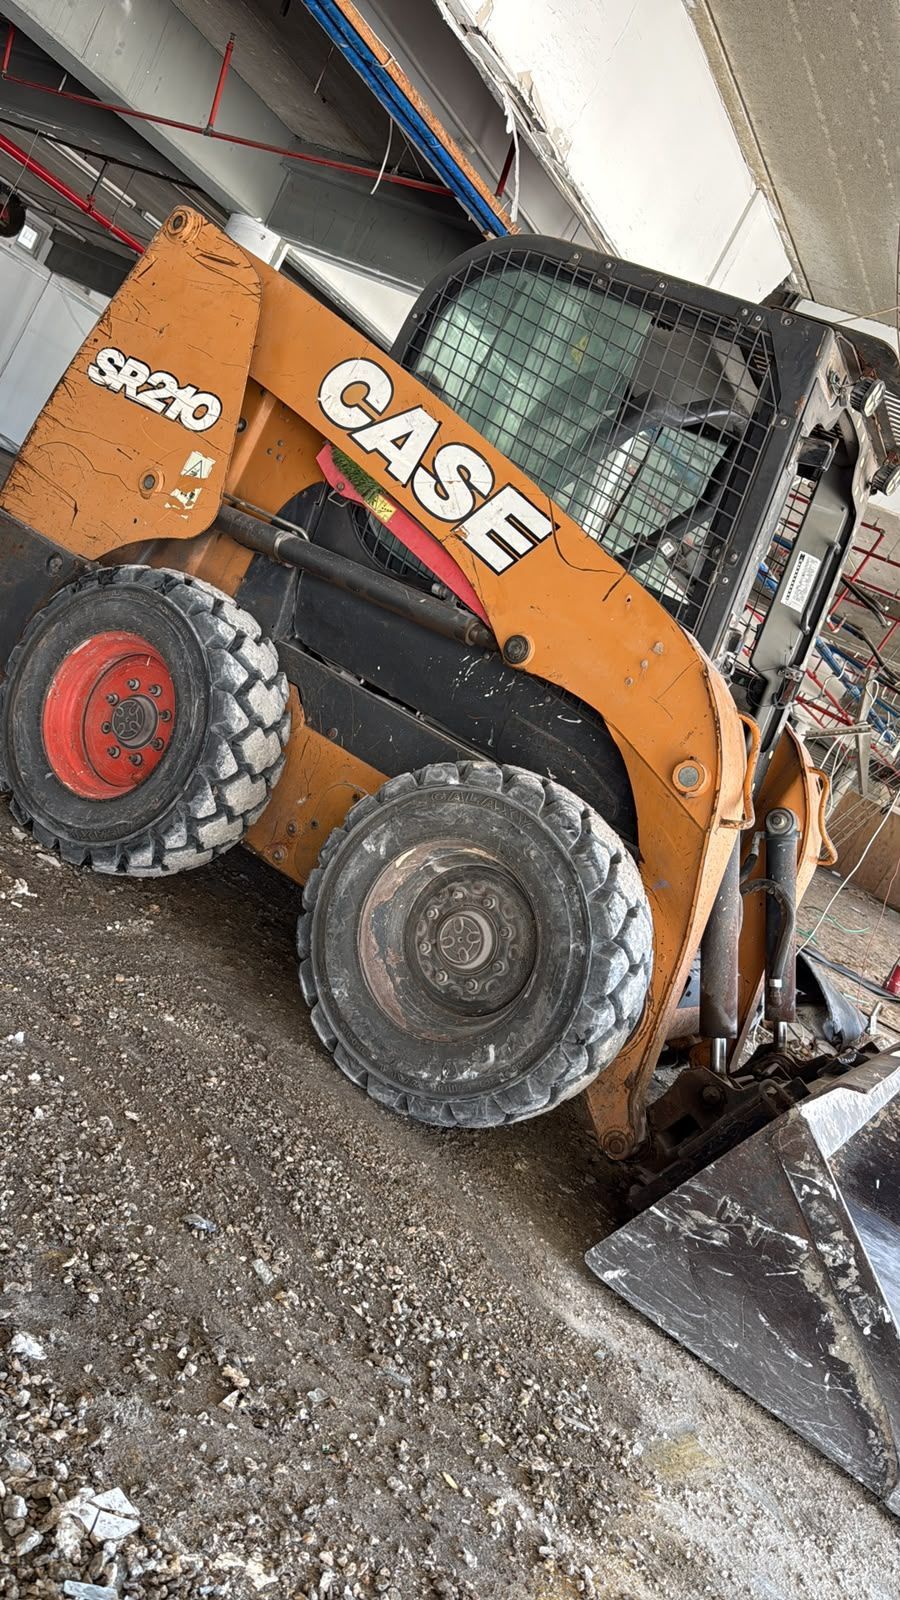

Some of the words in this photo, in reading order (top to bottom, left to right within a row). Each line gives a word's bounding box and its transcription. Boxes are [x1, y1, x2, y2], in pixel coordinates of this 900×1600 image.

[87, 346, 222, 432] SR210
[317, 357, 560, 576] CASE
[431, 790, 533, 829] GALAXY
